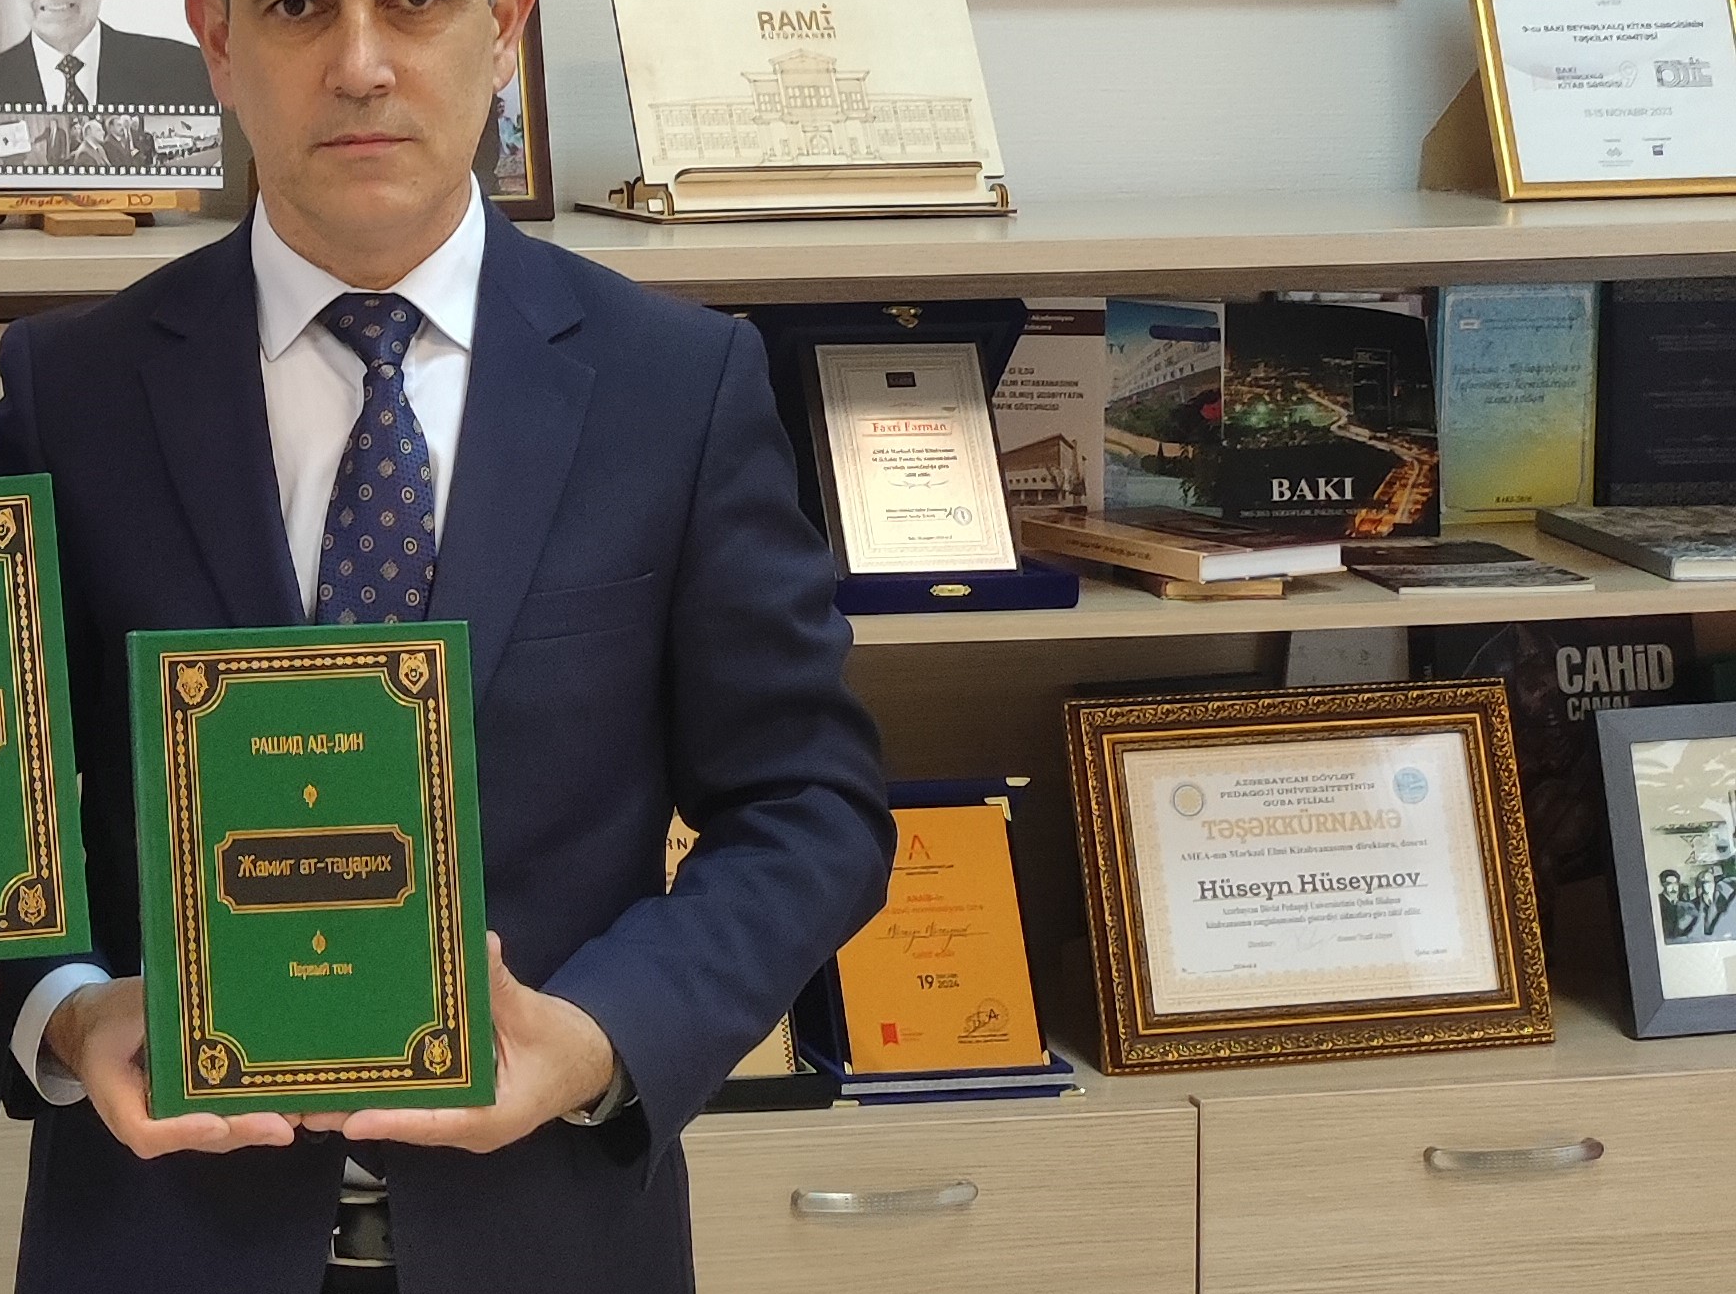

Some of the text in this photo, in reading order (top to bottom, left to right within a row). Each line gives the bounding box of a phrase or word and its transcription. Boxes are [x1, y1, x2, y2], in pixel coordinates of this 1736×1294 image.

[1271, 476, 1355, 501] BAKI
[250, 732, 364, 756] РАШИД АД-ДИН
[1201, 808, 1402, 844] TƏŞƏKKÜRNAMƏ
[237, 854, 392, 880] Жамиг ат-тауарих
[1197, 871, 1421, 900] Hüseyn Hüseynov
[289, 961, 353, 981] Первый том
[916, 974, 935, 989] 19
